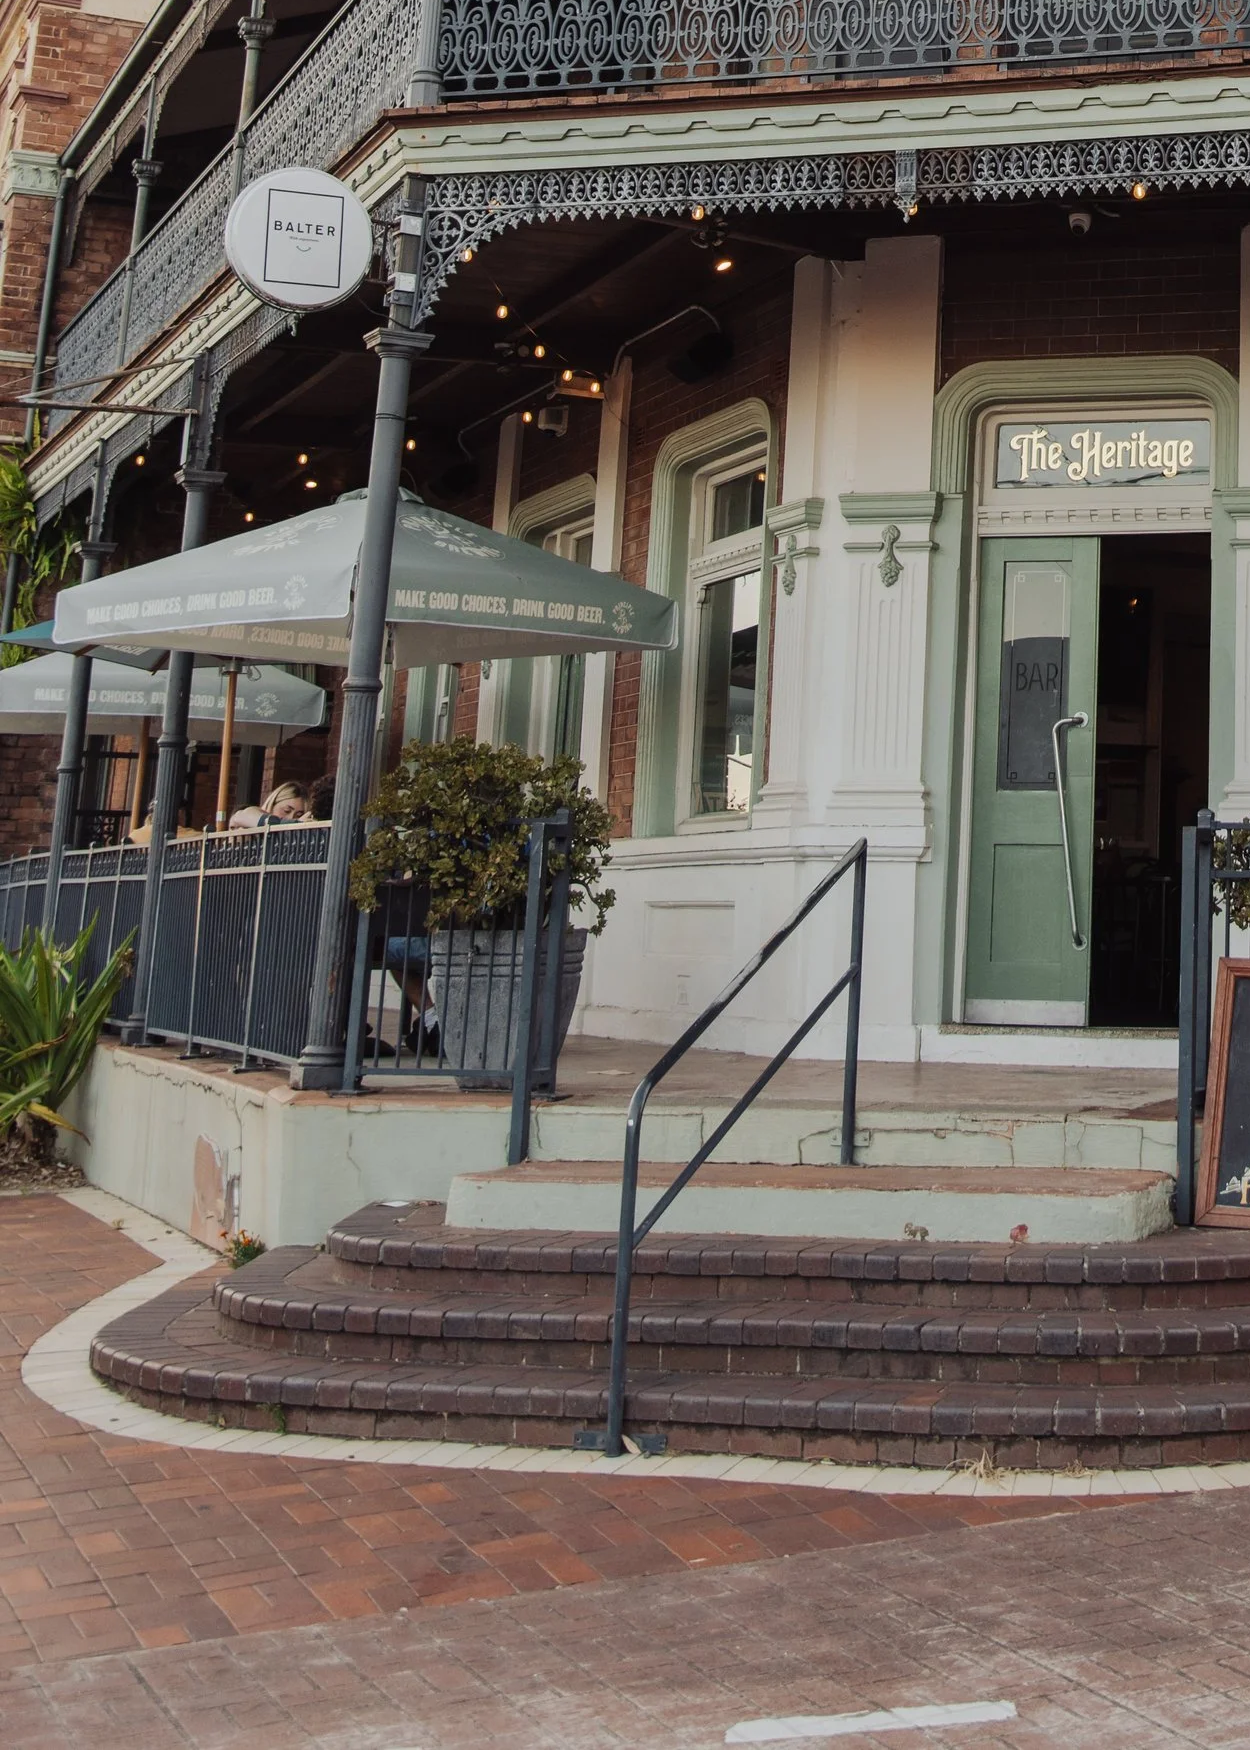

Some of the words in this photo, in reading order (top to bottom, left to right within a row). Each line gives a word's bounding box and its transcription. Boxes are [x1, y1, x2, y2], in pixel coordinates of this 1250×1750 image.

[273, 220, 336, 237] BALTER
[1010, 428, 1063, 481] The
[1067, 428, 1194, 481] Heritage
[86, 605, 111, 626] MAKE
[113, 603, 139, 622] GOOD
[141, 597, 185, 618] CHOICES,
[187, 593, 217, 613] DRINK
[219, 590, 246, 609] GOOD
[248, 586, 278, 607] BEER.
[394, 589, 426, 609] MAKE
[428, 590, 459, 611] GOOD
[461, 594, 510, 617] CHOICES,
[512, 600, 545, 618] DRINK
[547, 603, 575, 622] GOOD
[576, 605, 606, 625] BEER.
[1015, 662, 1059, 691] BAR
[34, 687, 66, 701] MAKE
[100, 689, 148, 706] CHOICES,
